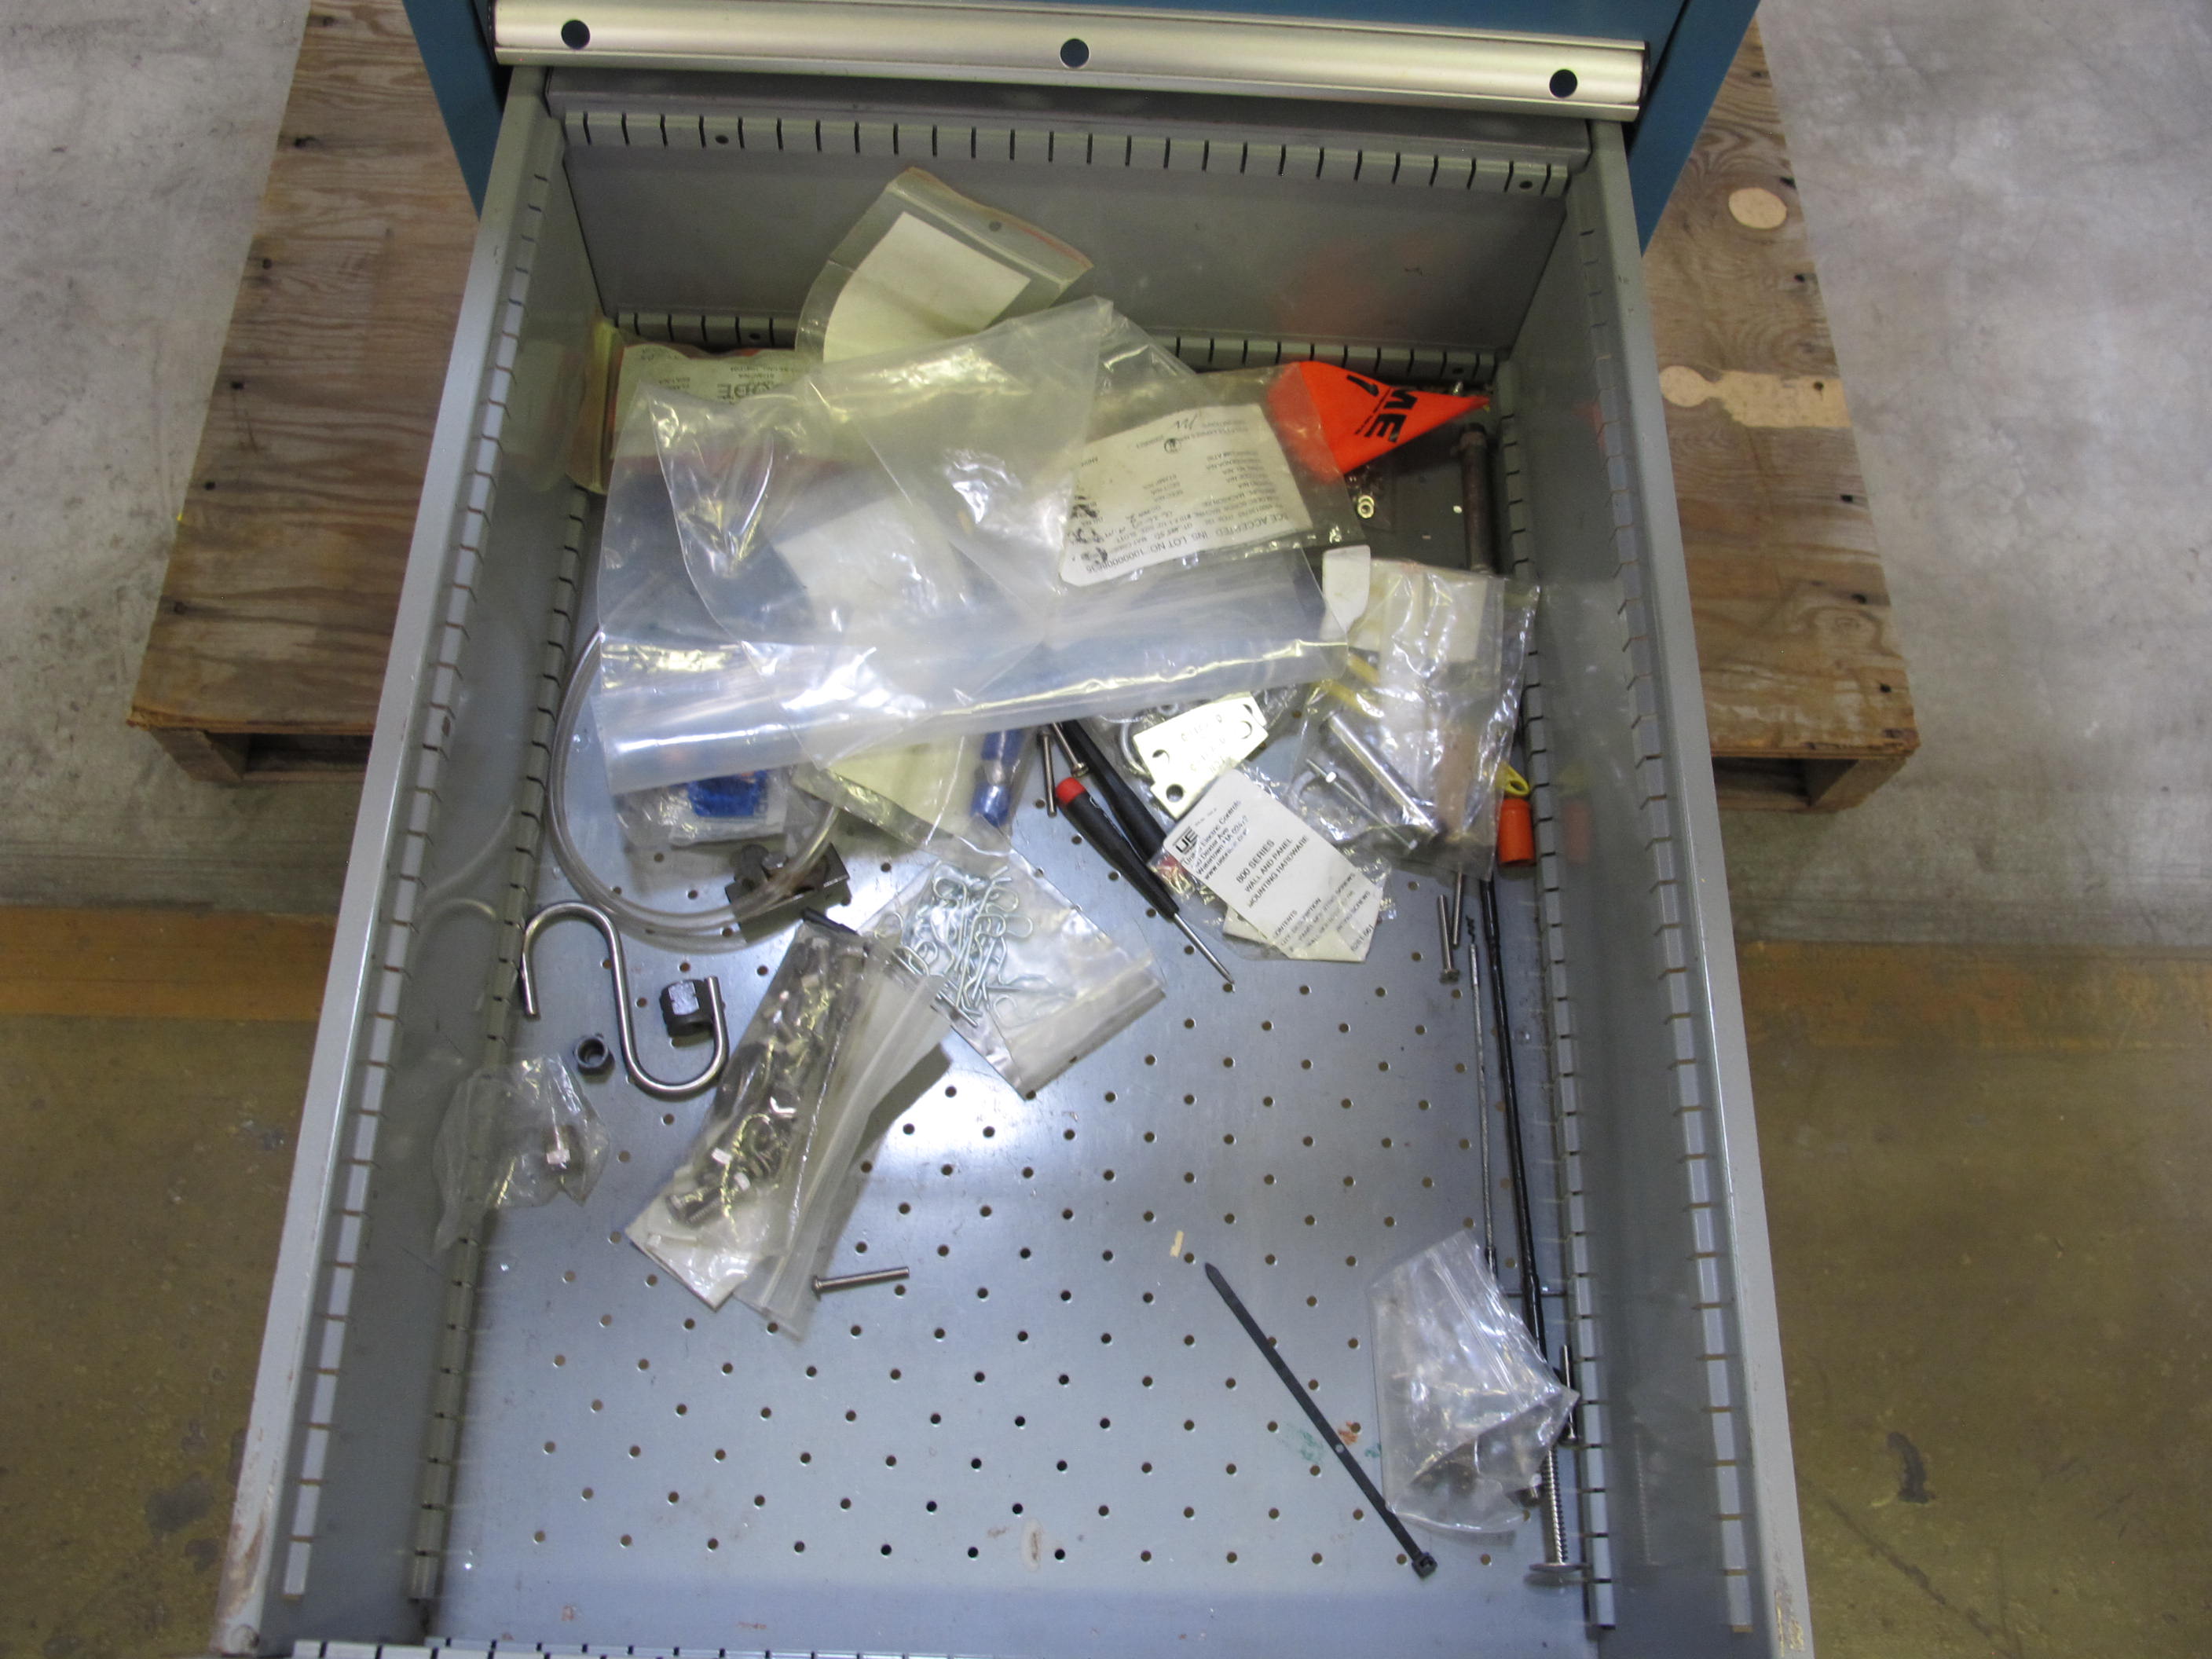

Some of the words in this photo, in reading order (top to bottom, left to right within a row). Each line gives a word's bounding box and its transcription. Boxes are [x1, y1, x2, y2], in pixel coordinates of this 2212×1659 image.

[1214, 516, 1268, 537] ACCEPTED
[1167, 536, 1187, 548] LOT
[1174, 827, 1199, 854] UE
[1184, 844, 1203, 865] Unitd
[1218, 798, 1243, 825] Controls
[1243, 873, 1262, 893] WALL
[1258, 858, 1275, 874] AND
[1270, 837, 1294, 860] PANEL
[1246, 837, 1276, 870] SERIES
[1244, 871, 1280, 908] MOUNTING
[1273, 834, 1311, 873] HARDWARE
[1334, 871, 1357, 895] SCREWS
